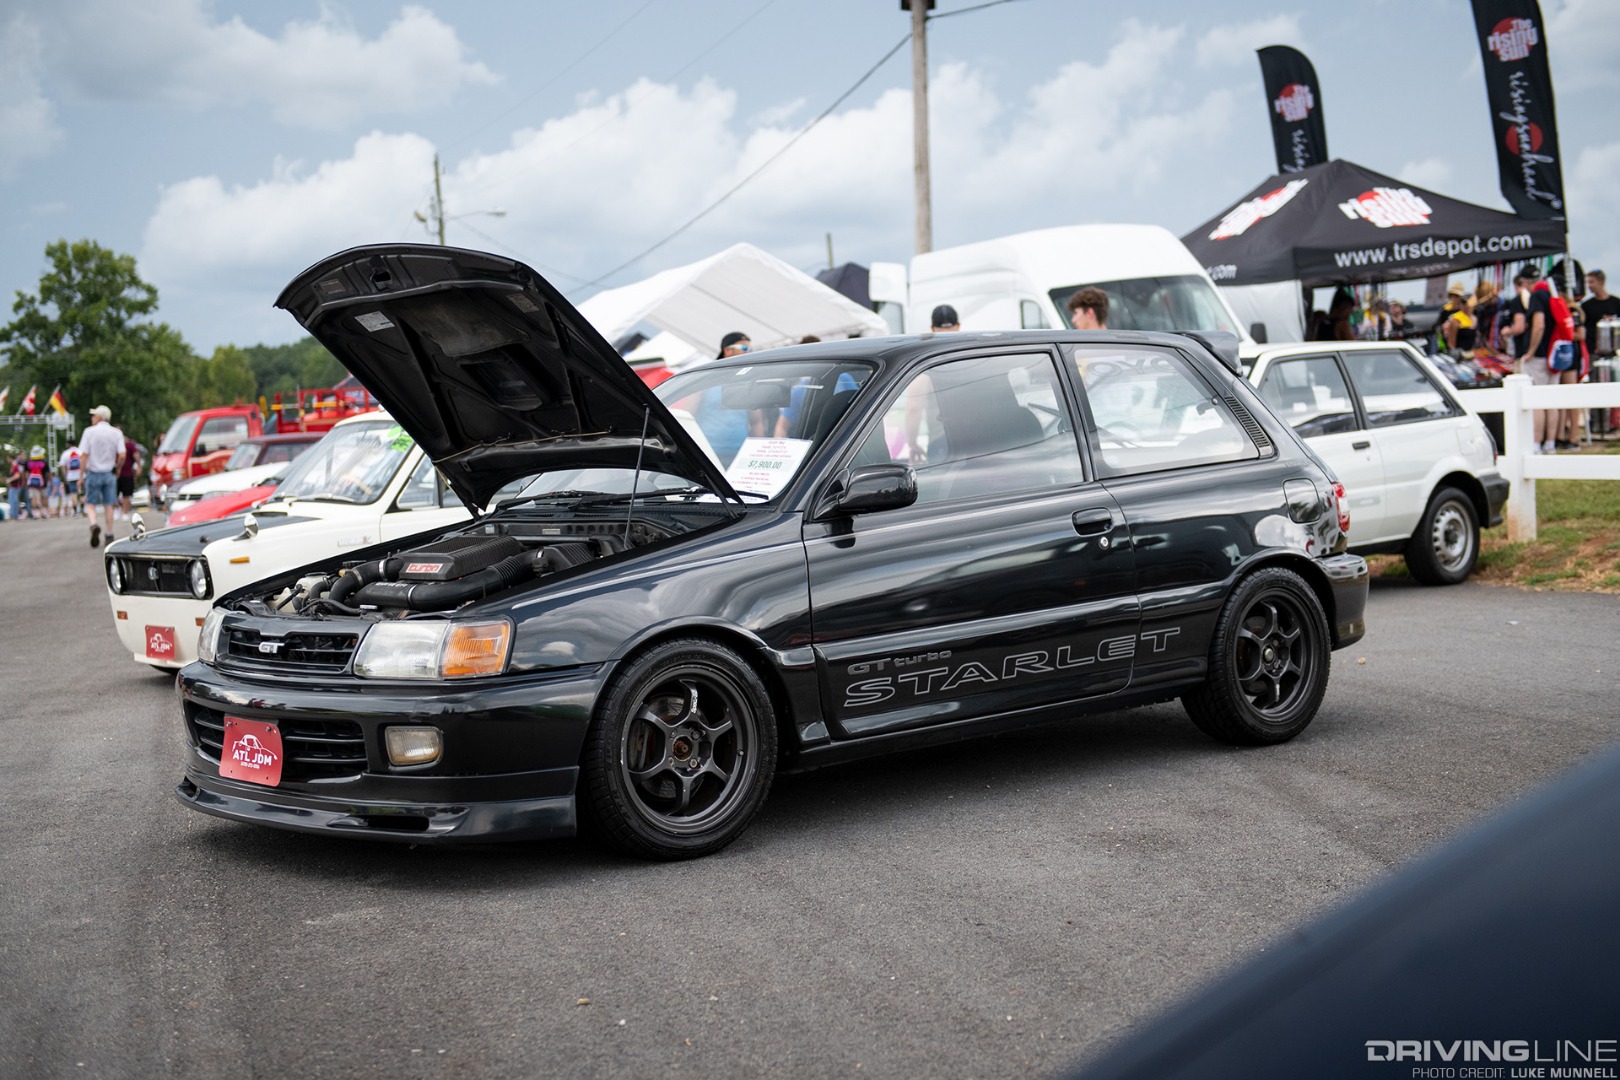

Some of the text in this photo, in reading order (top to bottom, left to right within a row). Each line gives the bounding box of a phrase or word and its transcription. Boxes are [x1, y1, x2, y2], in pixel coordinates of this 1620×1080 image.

[1511, 19, 1532, 31] The
[1487, 27, 1538, 51] rising
[1499, 45, 1530, 61] sun
[1334, 234, 1533, 268] www.trsdepot.com
[748, 460, 782, 470] $7,900.00
[259, 641, 285, 654] GT
[843, 627, 1181, 707] STARLET
[847, 650, 952, 675] GT turbo
[233, 749, 250, 763] ATL
[252, 752, 272, 767] JDM
